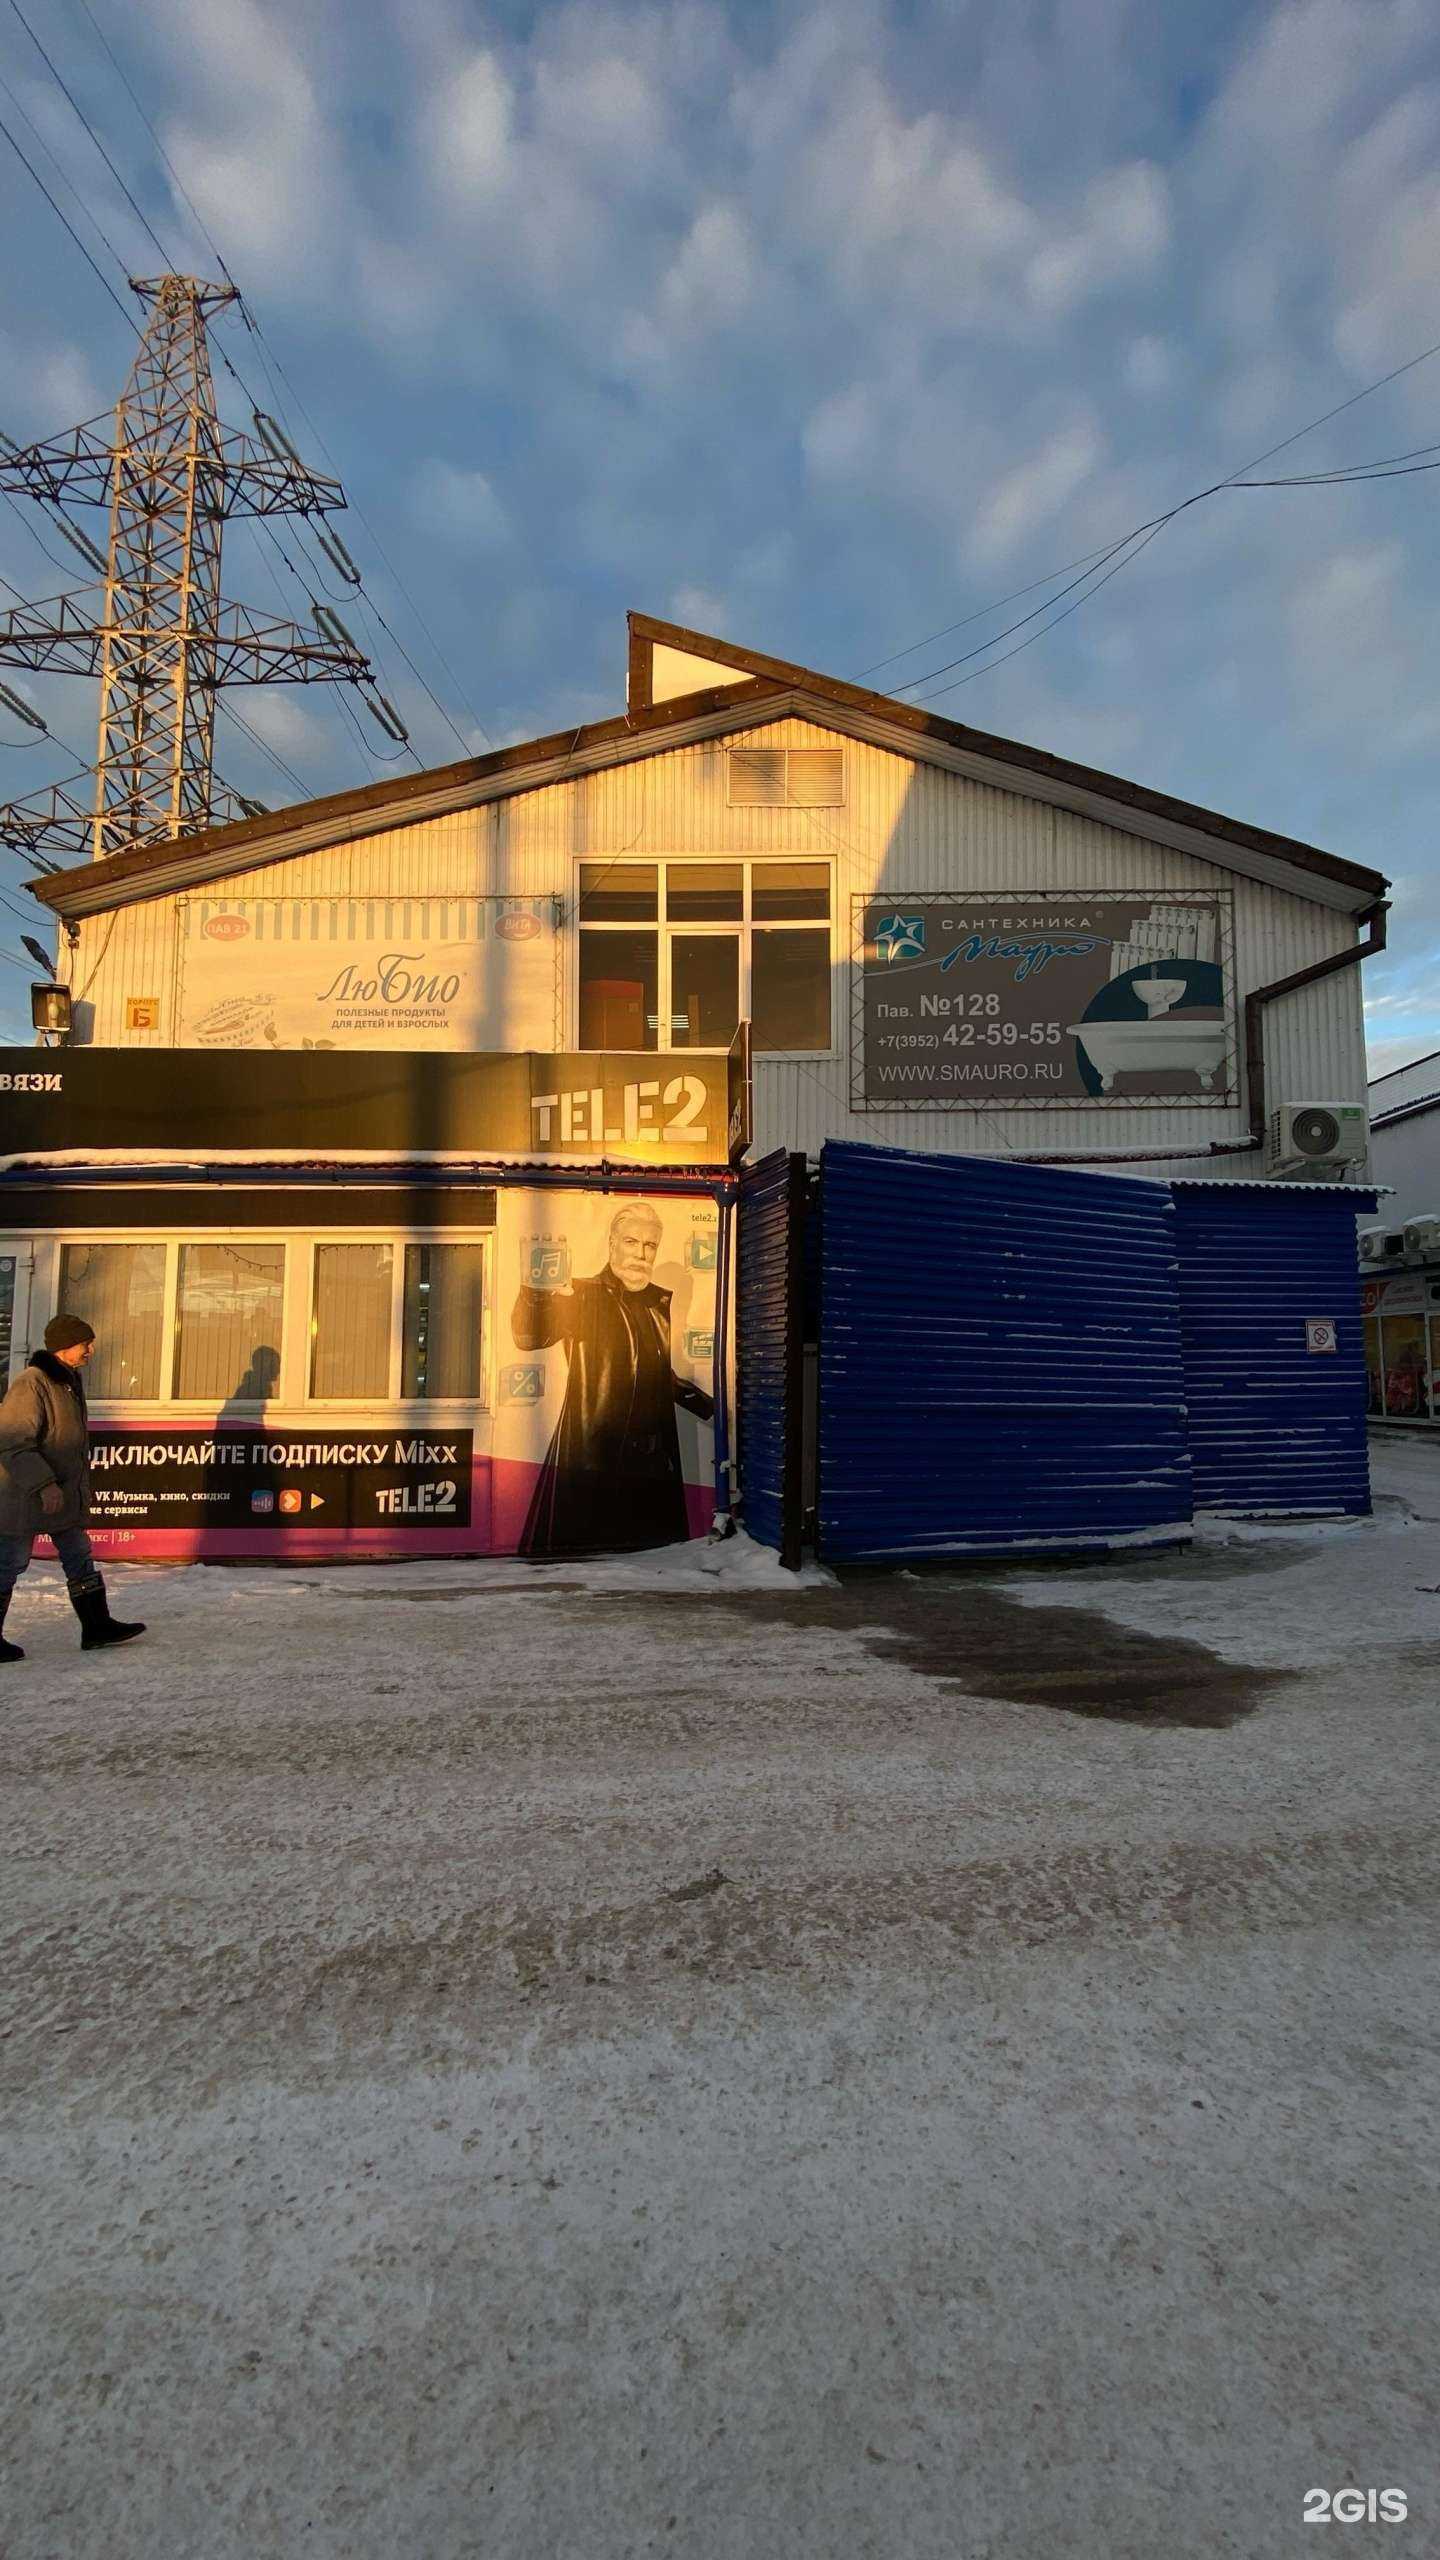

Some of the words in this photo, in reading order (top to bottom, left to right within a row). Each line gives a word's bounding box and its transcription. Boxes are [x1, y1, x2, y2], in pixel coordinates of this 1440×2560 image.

[233, 923, 247, 934] 21
[941, 917, 1092, 930] САНТЕХНИКА
[940, 934, 1098, 982] Мауро
[316, 953, 460, 1003] ЛюБио
[336, 1008, 389, 1017] ПОЛЕЗНЫЕ
[391, 1008, 446, 1018] ПРОДУКТЫ
[877, 1004, 914, 1017] Пав.
[920, 993, 1000, 1016] №128
[133, 1008, 151, 1027] Б
[332, 1020, 351, 1029] ДЛЯ
[354, 1018, 385, 1029] ДЕТЕЙ
[387, 1020, 395, 1028] И
[397, 1020, 449, 1029] ВЗРОСЛЫХ
[878, 1034, 939, 1050] +7(3952)
[943, 1022, 1062, 1047] 42-59-55
[879, 1062, 1064, 1082] WWW.SMAURO.RU
[531, 1075, 708, 1142] TELE2
[88, 1440, 246, 1470] ДКЛЮЧАЙТЕ
[252, 1444, 389, 1469] ПОДПИСКУ
[395, 1439, 458, 1465] Mixx
[95, 1490, 111, 1502] VK
[113, 1490, 157, 1504] Музыка,
[160, 1492, 189, 1502] кино,
[191, 1492, 231, 1502] скидки
[375, 1480, 457, 1513] TELE2
[104, 1507, 148, 1517] сервисы
[117, 1531, 136, 1543] 18+
